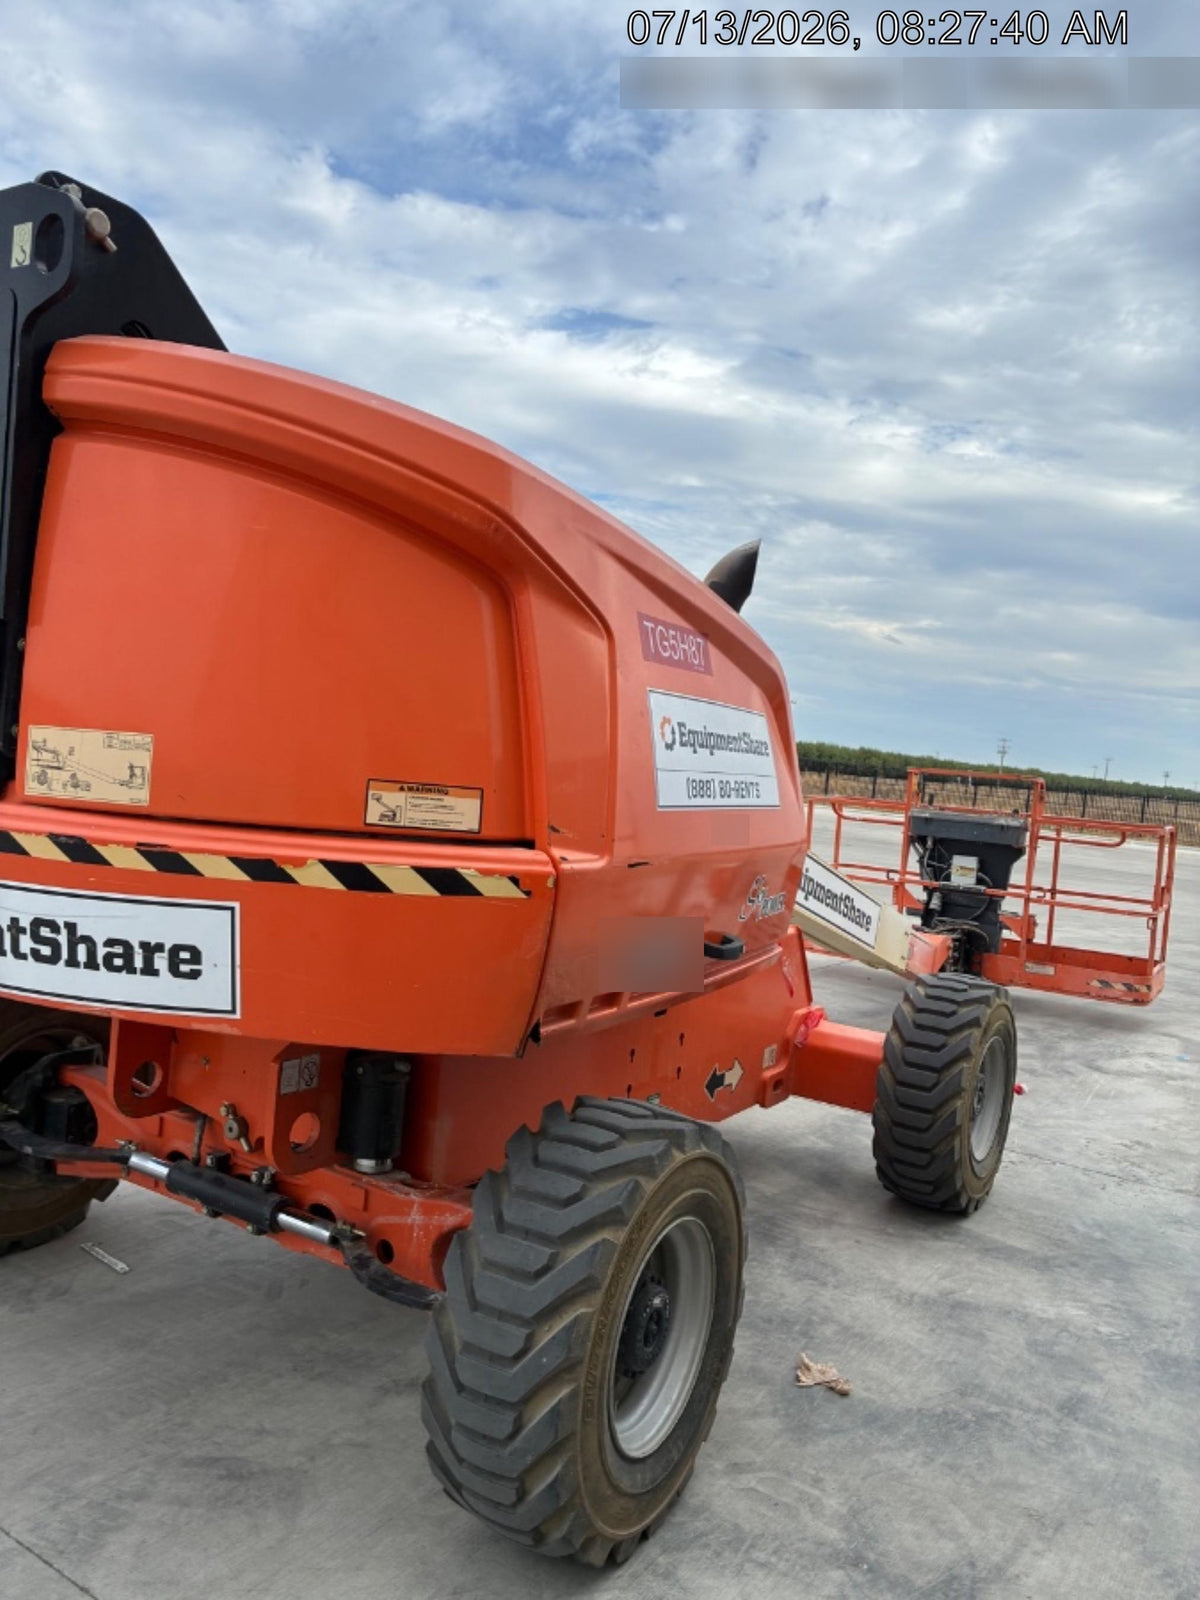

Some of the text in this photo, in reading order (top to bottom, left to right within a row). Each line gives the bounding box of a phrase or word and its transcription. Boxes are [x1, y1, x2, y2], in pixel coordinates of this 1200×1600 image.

[643, 620, 705, 666] TG5H87
[677, 720, 770, 757] EquipmentShare
[686, 777, 716, 800] (888)
